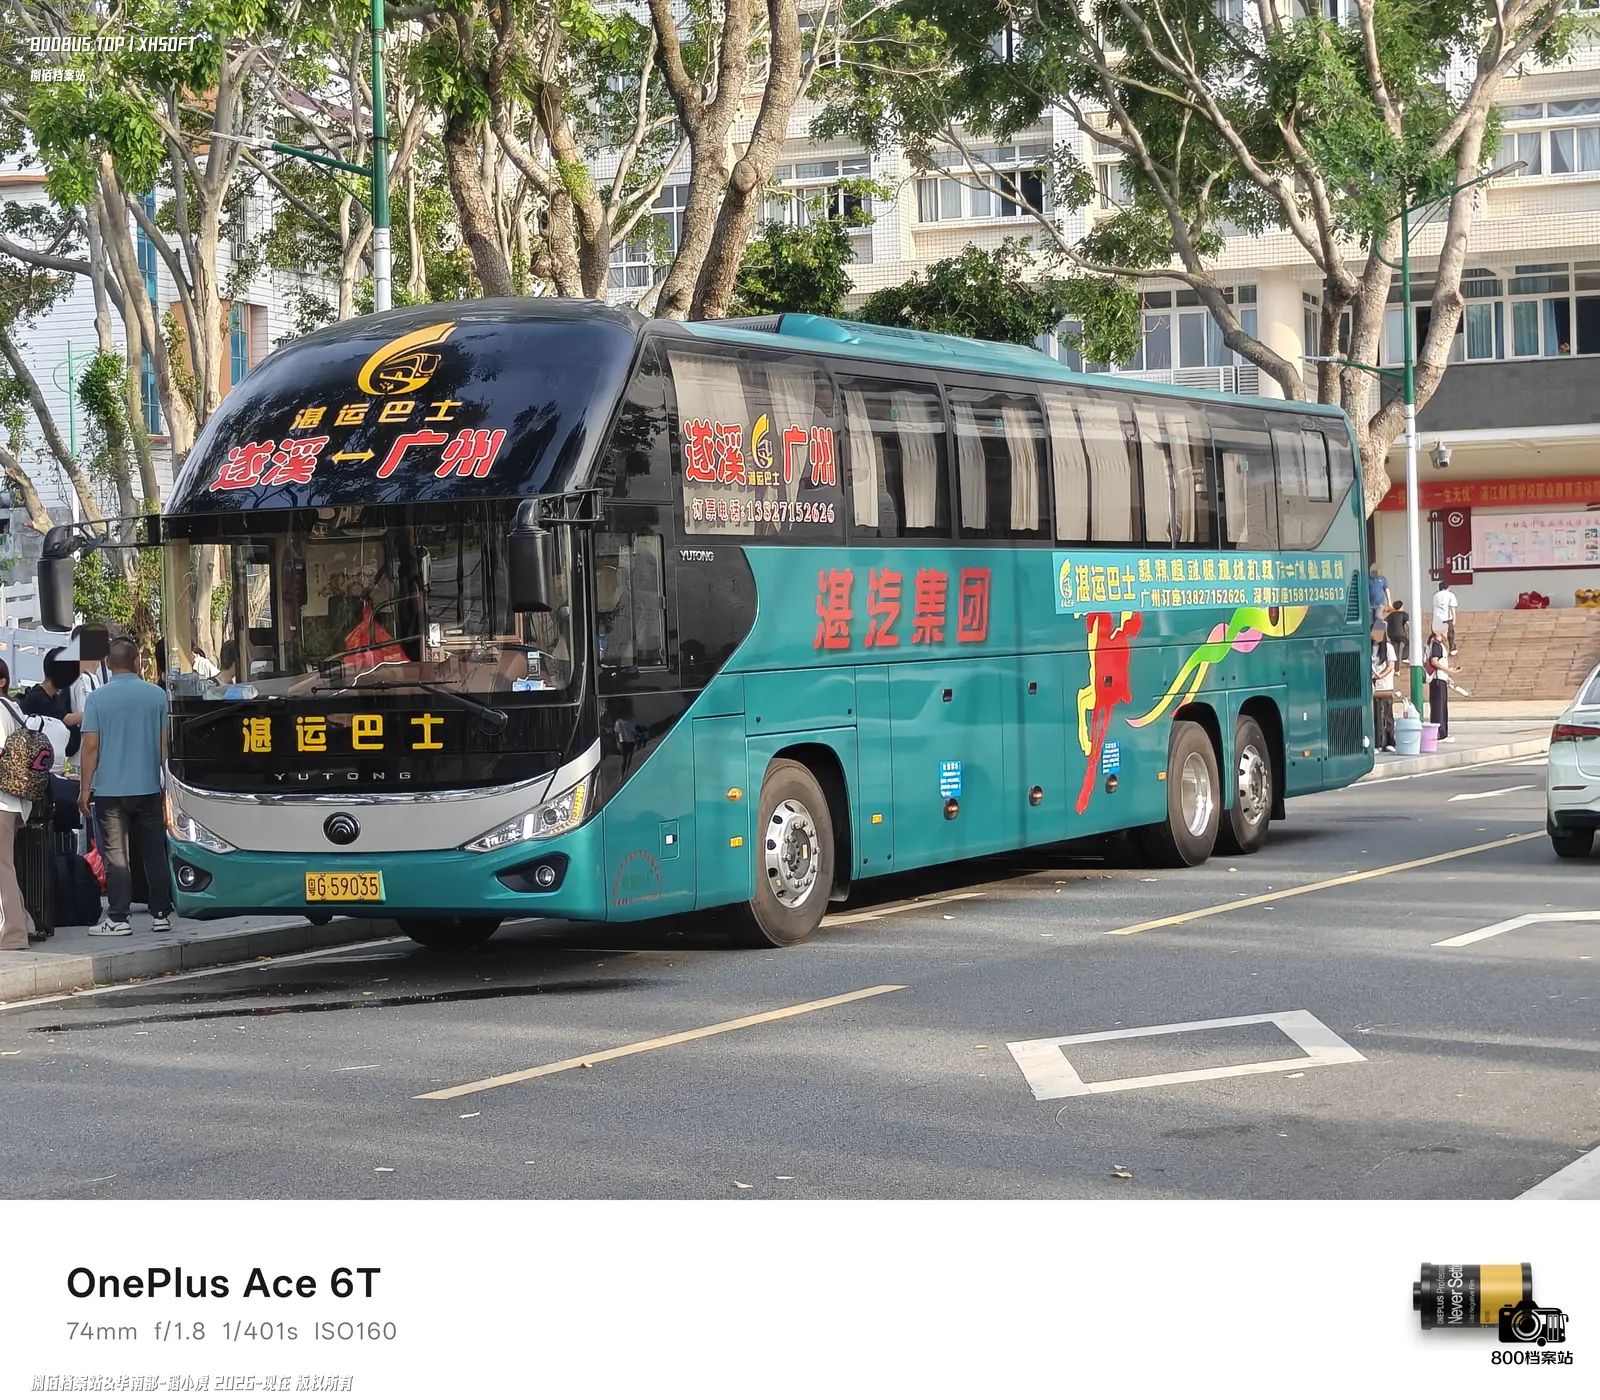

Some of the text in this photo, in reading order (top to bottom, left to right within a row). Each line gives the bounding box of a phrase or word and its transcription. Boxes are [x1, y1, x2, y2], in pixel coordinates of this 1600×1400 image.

[289, 399, 463, 430] 湛运巴士
[209, 428, 507, 492] 遂溪 广州
[684, 417, 837, 487] 遂溪 广州
[680, 550, 715, 562] YUTONG
[1074, 564, 1136, 602] 湛运巴士
[813, 567, 992, 650] 湛汽集团
[242, 712, 444, 754] 湛运巴士
[274, 772, 412, 781] YUTONG
